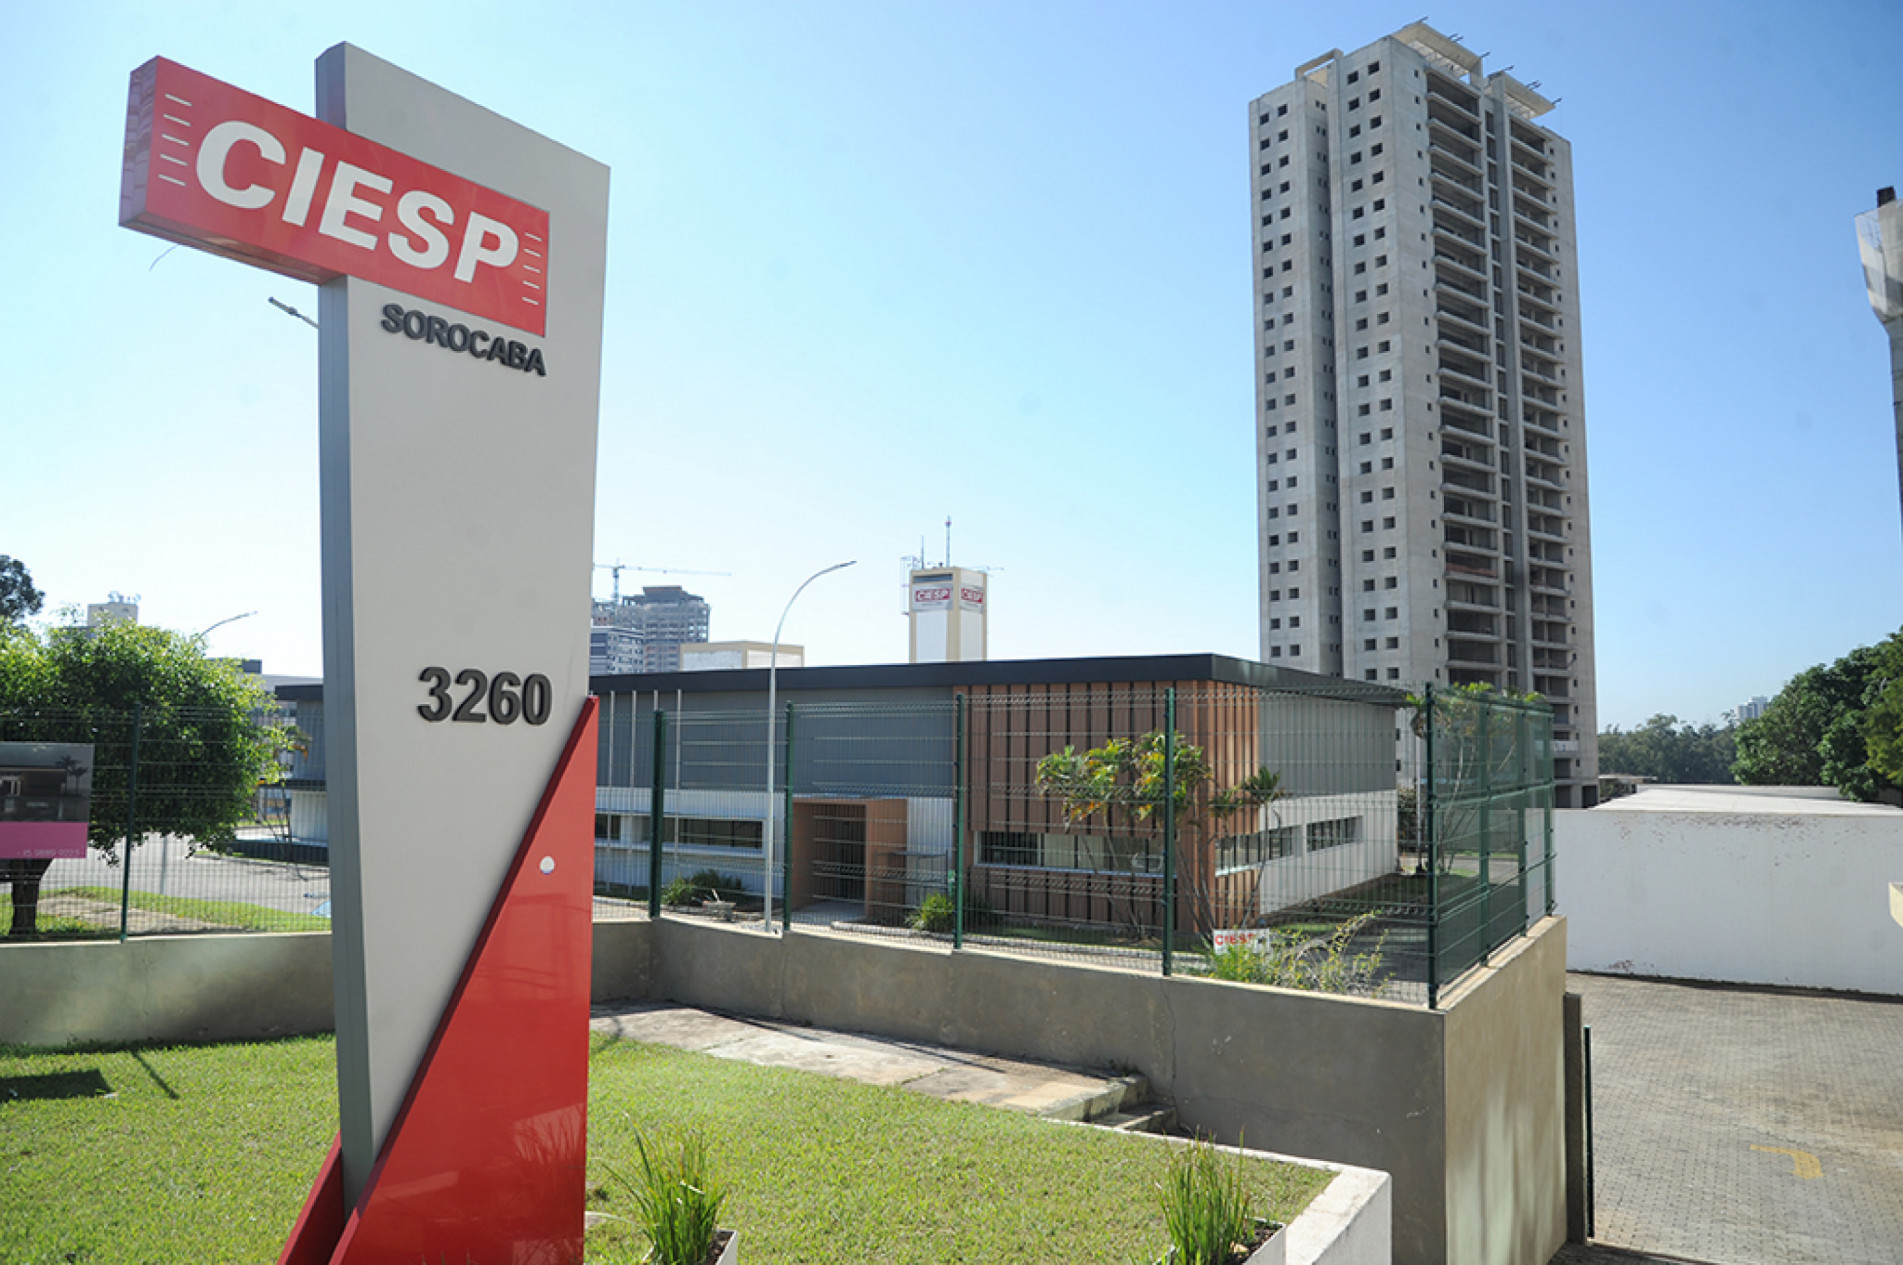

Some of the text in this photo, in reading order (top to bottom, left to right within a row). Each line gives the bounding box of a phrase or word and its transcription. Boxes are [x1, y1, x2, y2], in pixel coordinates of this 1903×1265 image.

[196, 120, 520, 284] CIESP
[380, 302, 547, 377] SOROCABA
[416, 666, 552, 726] 3260
